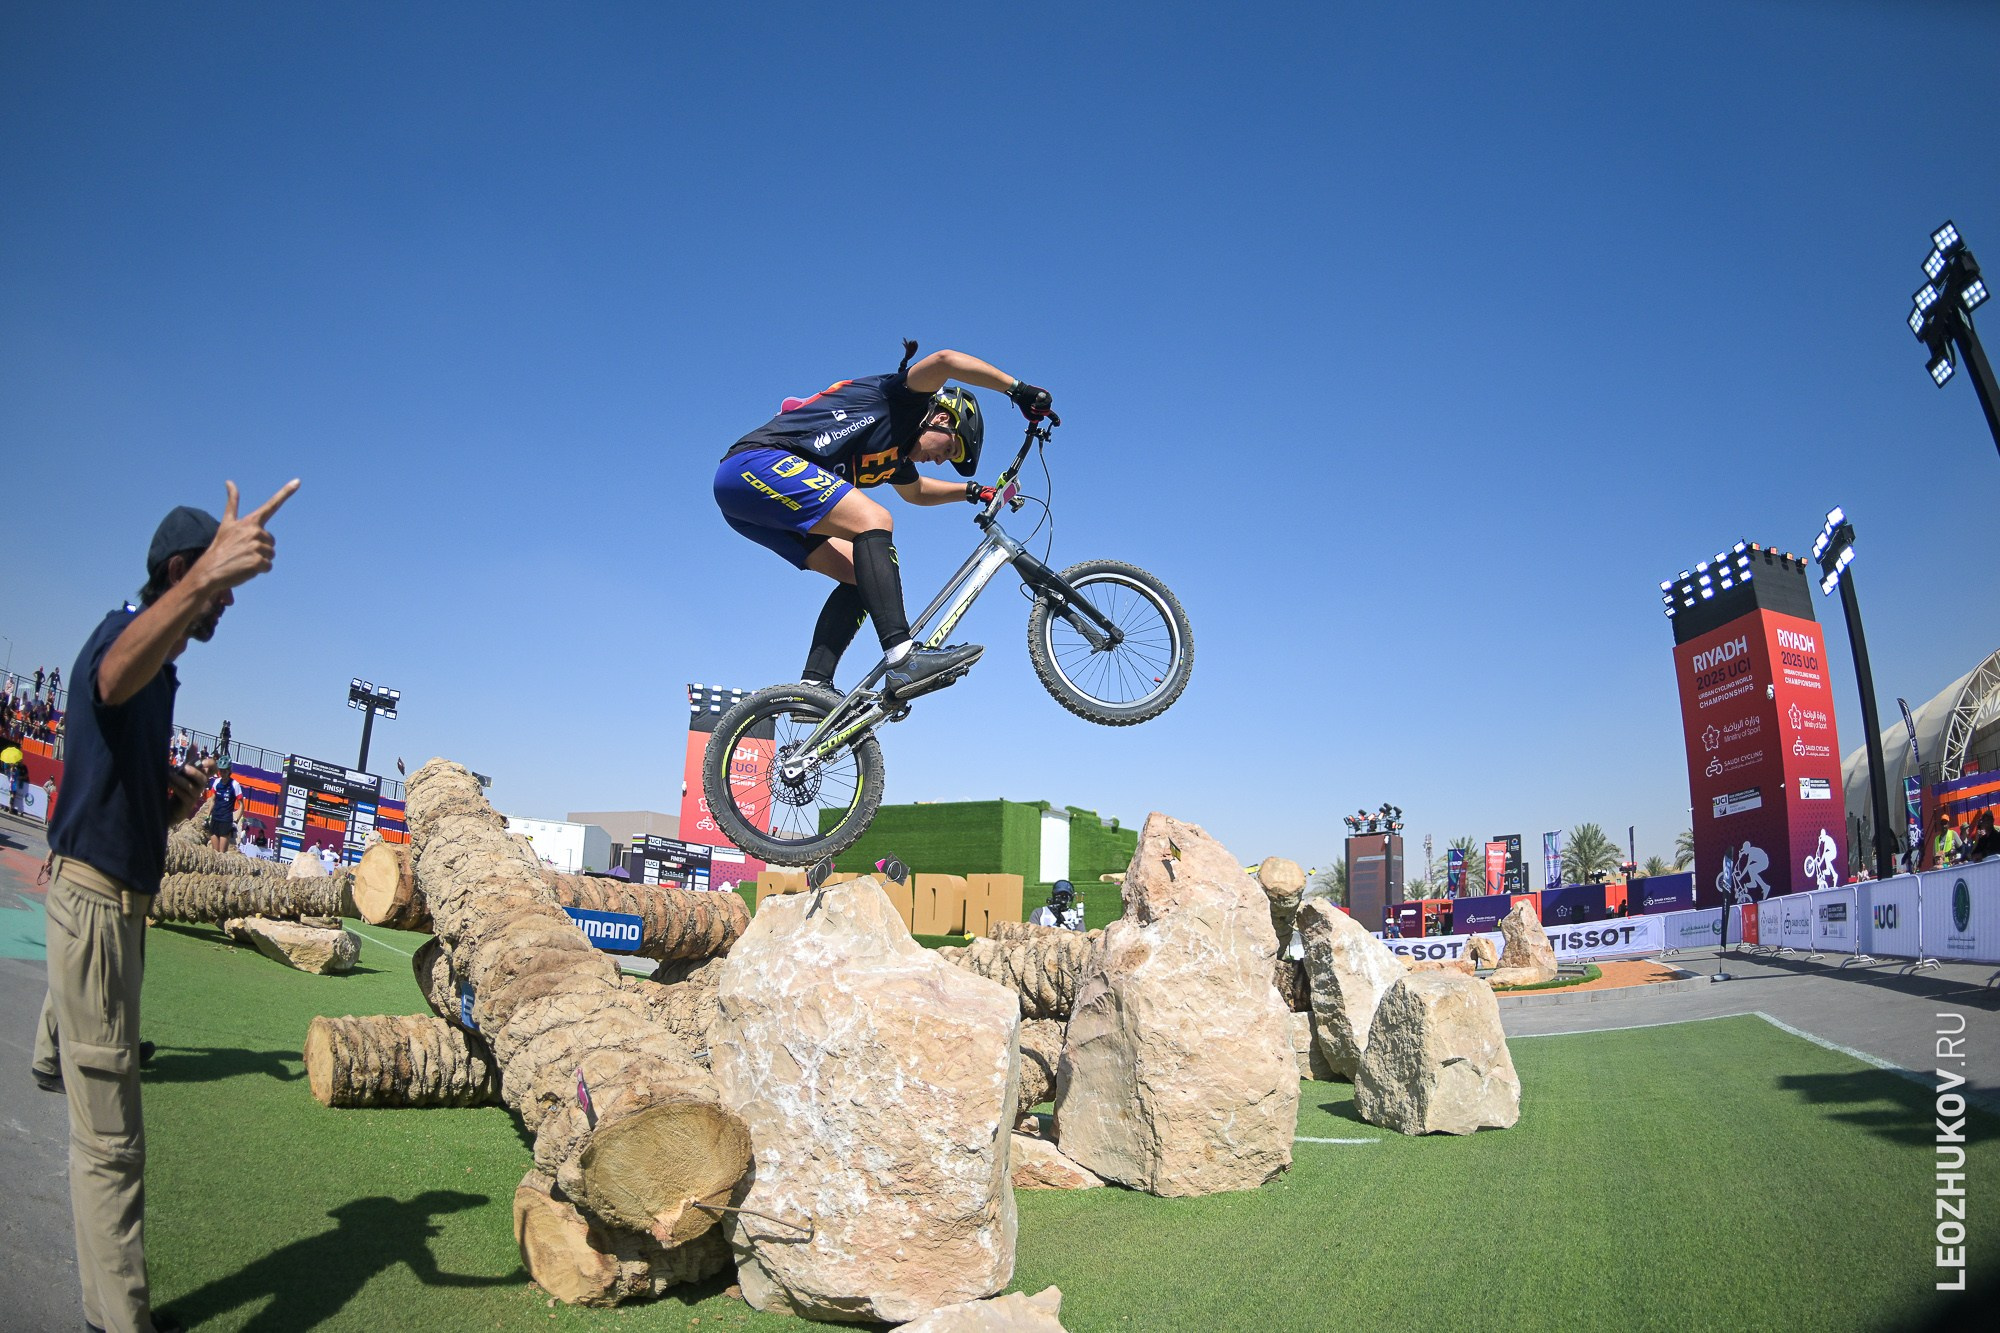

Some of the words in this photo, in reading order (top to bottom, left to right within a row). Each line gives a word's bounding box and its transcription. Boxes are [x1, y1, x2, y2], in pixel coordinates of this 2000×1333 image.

[831, 415, 876, 441] Iberdrola
[741, 471, 802, 511] COMAS
[818, 478, 846, 503] COMA
[1777, 629, 1815, 653] RIYADH
[1693, 635, 1748, 673] RIYADH
[1781, 651, 1802, 667] 2025
[1803, 655, 1818, 671] UCI
[1696, 668, 1726, 691] 2025
[1728, 658, 1751, 678] UCI
[1699, 683, 1754, 709] CHAMPIONSHIPS
[297, 760, 311, 769] UCI
[735, 762, 757, 773] UCI
[292, 787, 307, 797] UCI
[323, 783, 345, 795] FINISH
[1715, 794, 1728, 806] UCI
[1879, 904, 1897, 929] UCI
[1388, 942, 1463, 961] SSOT
